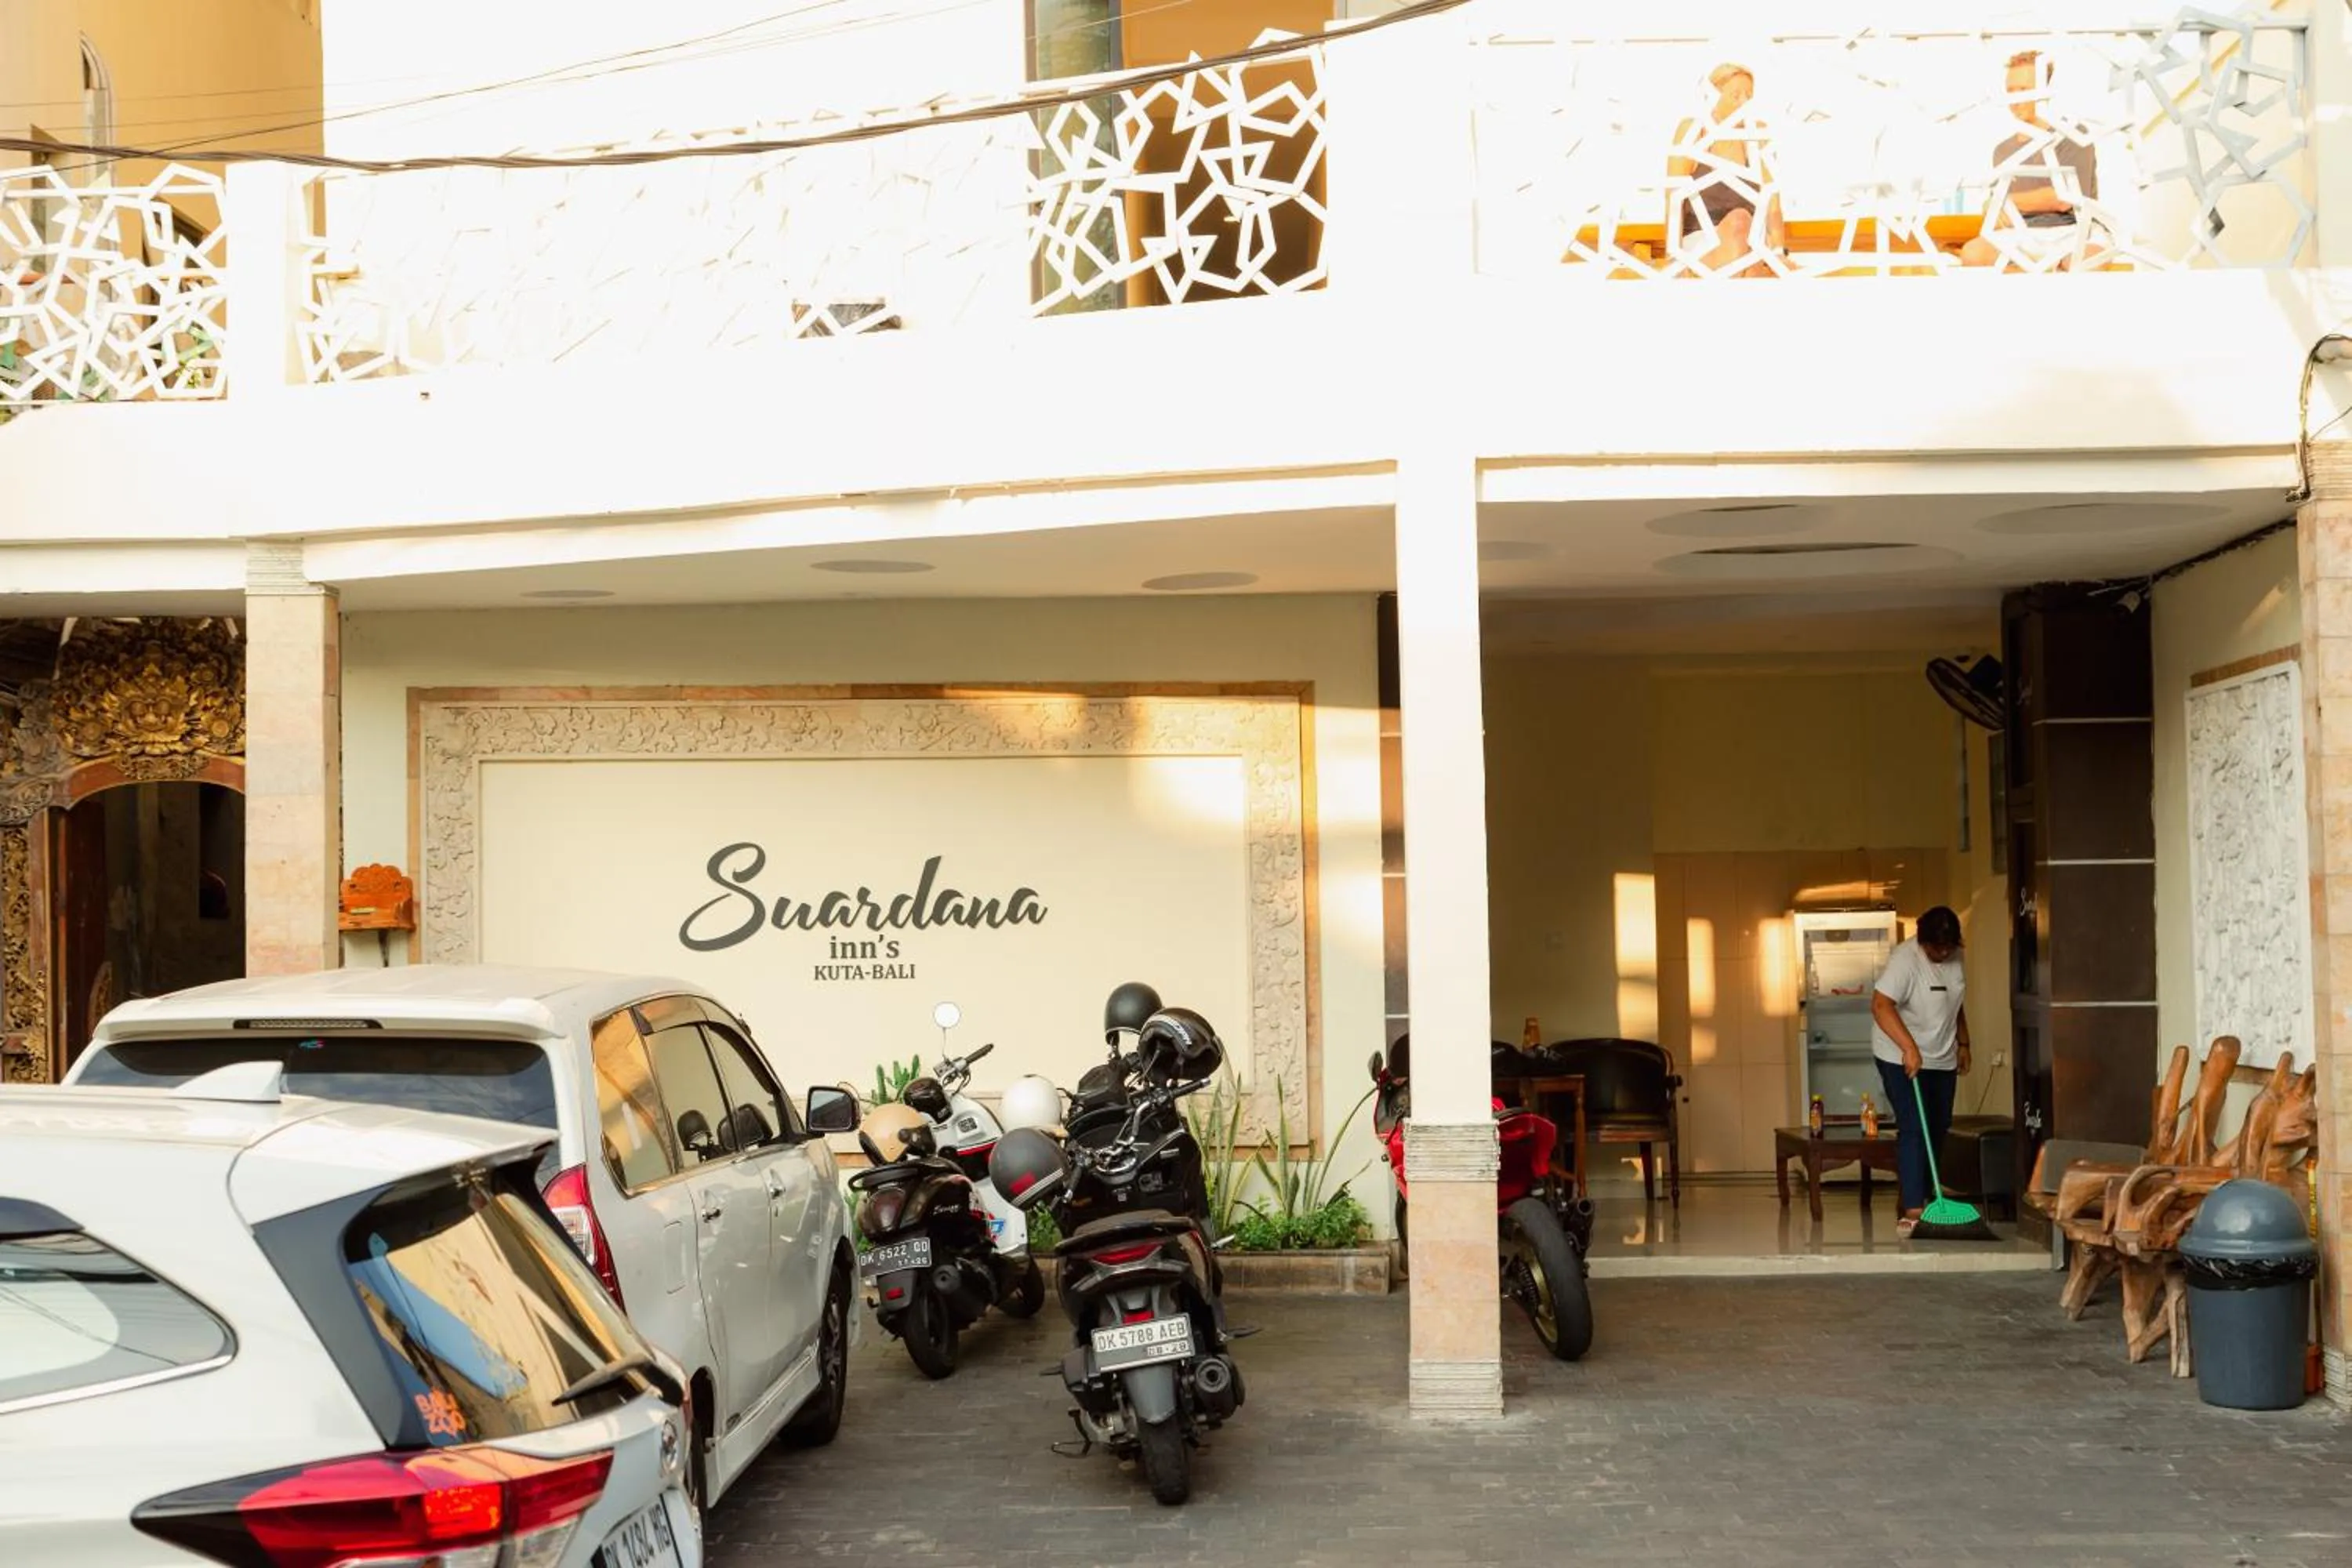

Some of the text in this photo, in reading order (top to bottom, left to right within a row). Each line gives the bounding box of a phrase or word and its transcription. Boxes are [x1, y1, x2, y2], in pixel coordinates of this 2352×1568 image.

[678, 841, 1048, 952] Suardana
[829, 934, 900, 960] inn's
[814, 964, 916, 982] KUTA-BALI
[879, 1244, 907, 1260] 6522
[1097, 1332, 1116, 1351] DK
[1120, 1327, 1154, 1347] 5788
